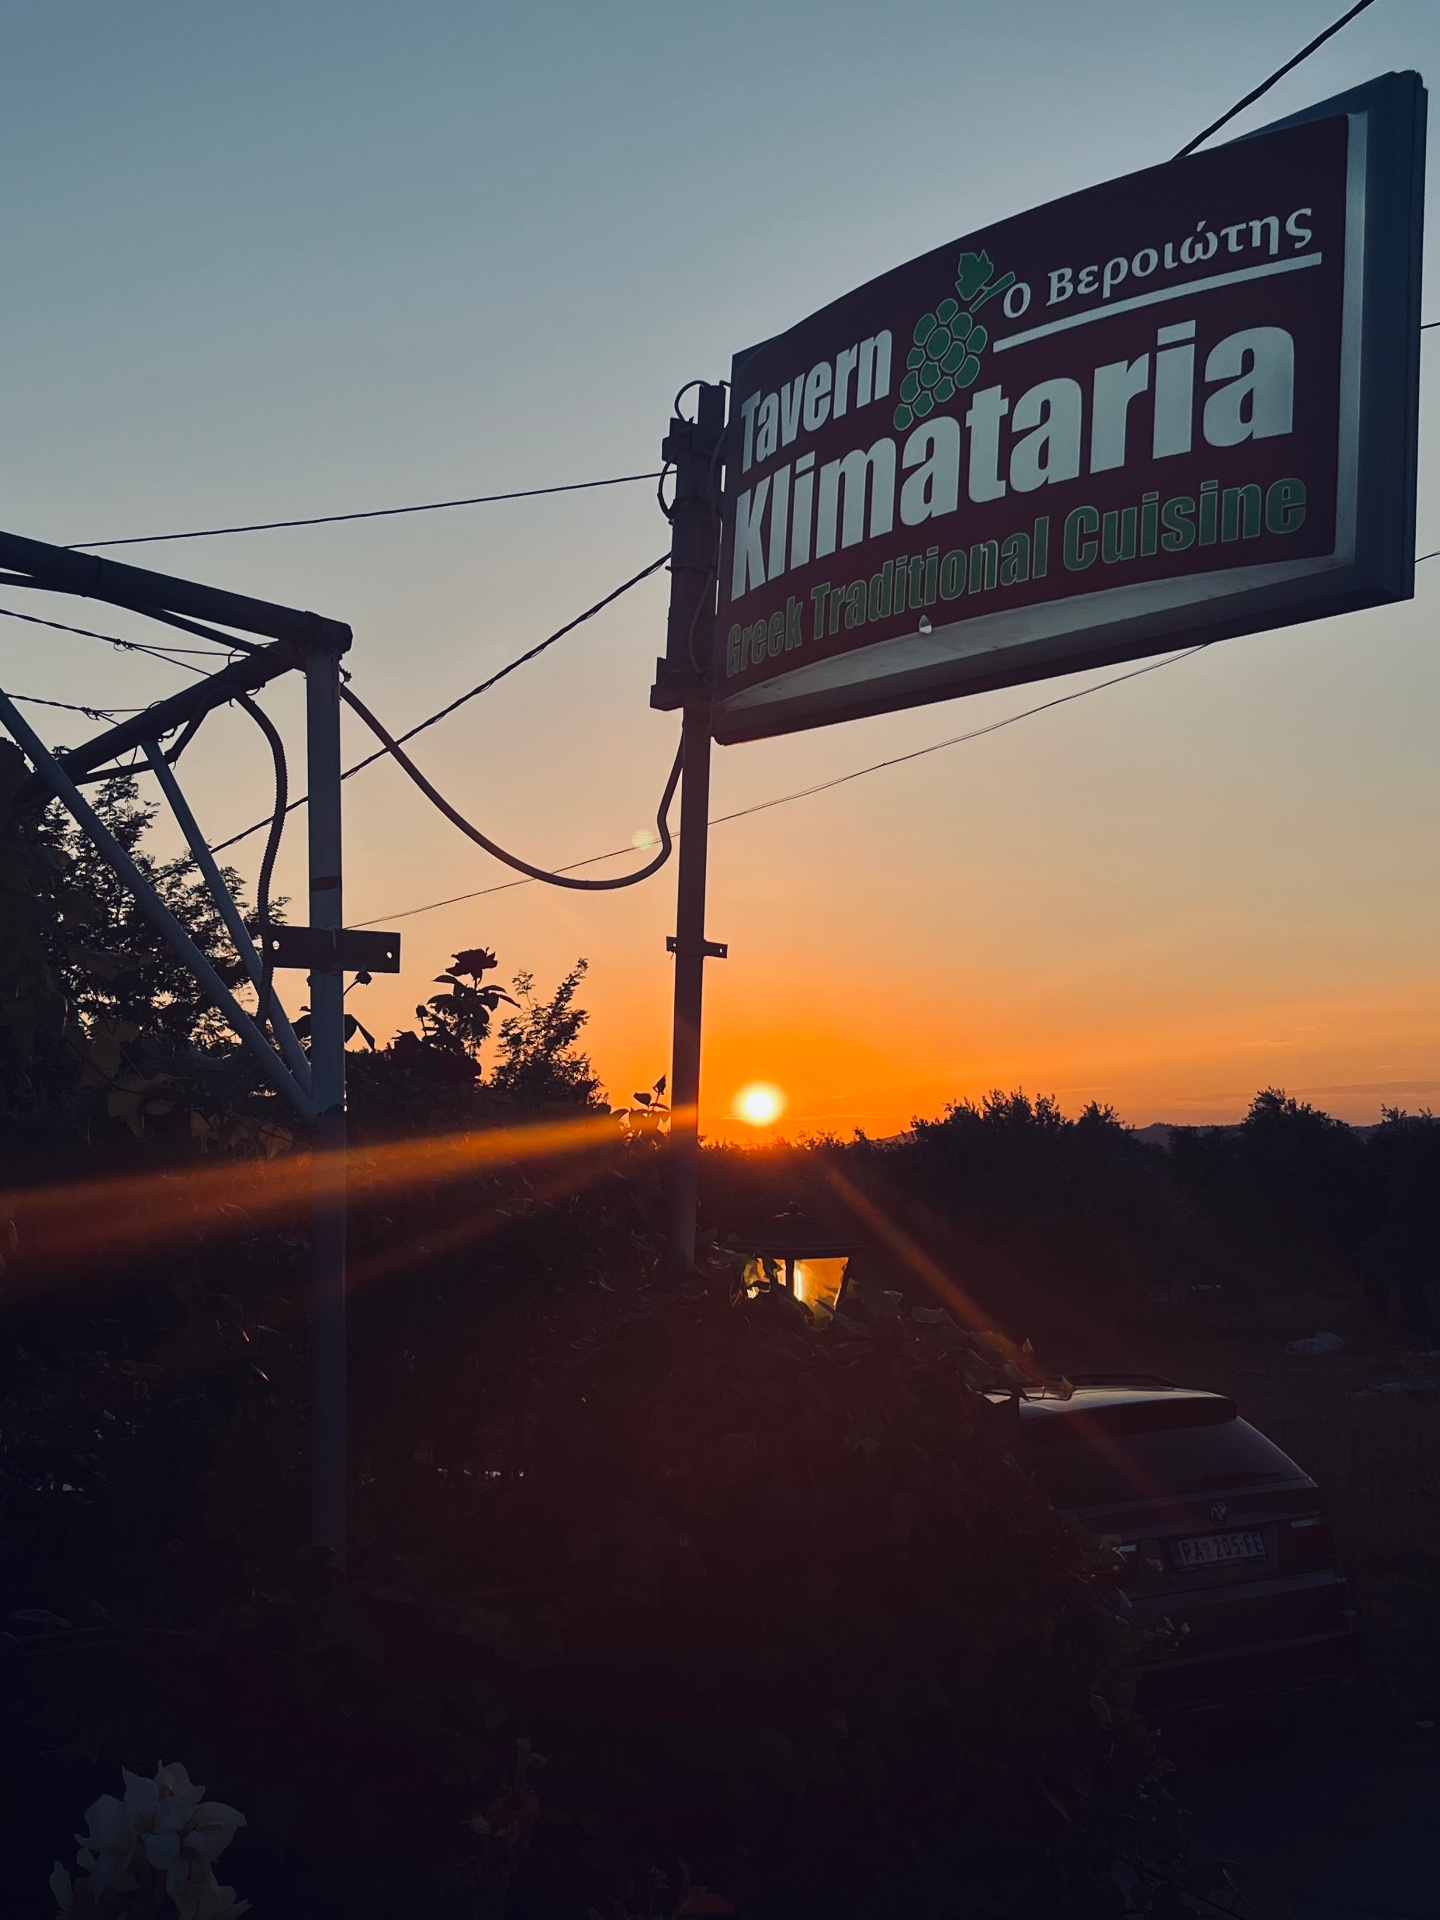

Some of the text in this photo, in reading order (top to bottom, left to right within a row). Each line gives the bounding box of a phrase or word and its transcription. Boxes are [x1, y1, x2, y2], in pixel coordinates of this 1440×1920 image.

[1045, 207, 1312, 307] Βεροιώτης
[731, 319, 1295, 602] Klimataria
[741, 329, 892, 474] Tavern
[725, 477, 1307, 678] Greek Traditional Cuisine
[1181, 1541, 1204, 1562] PA
